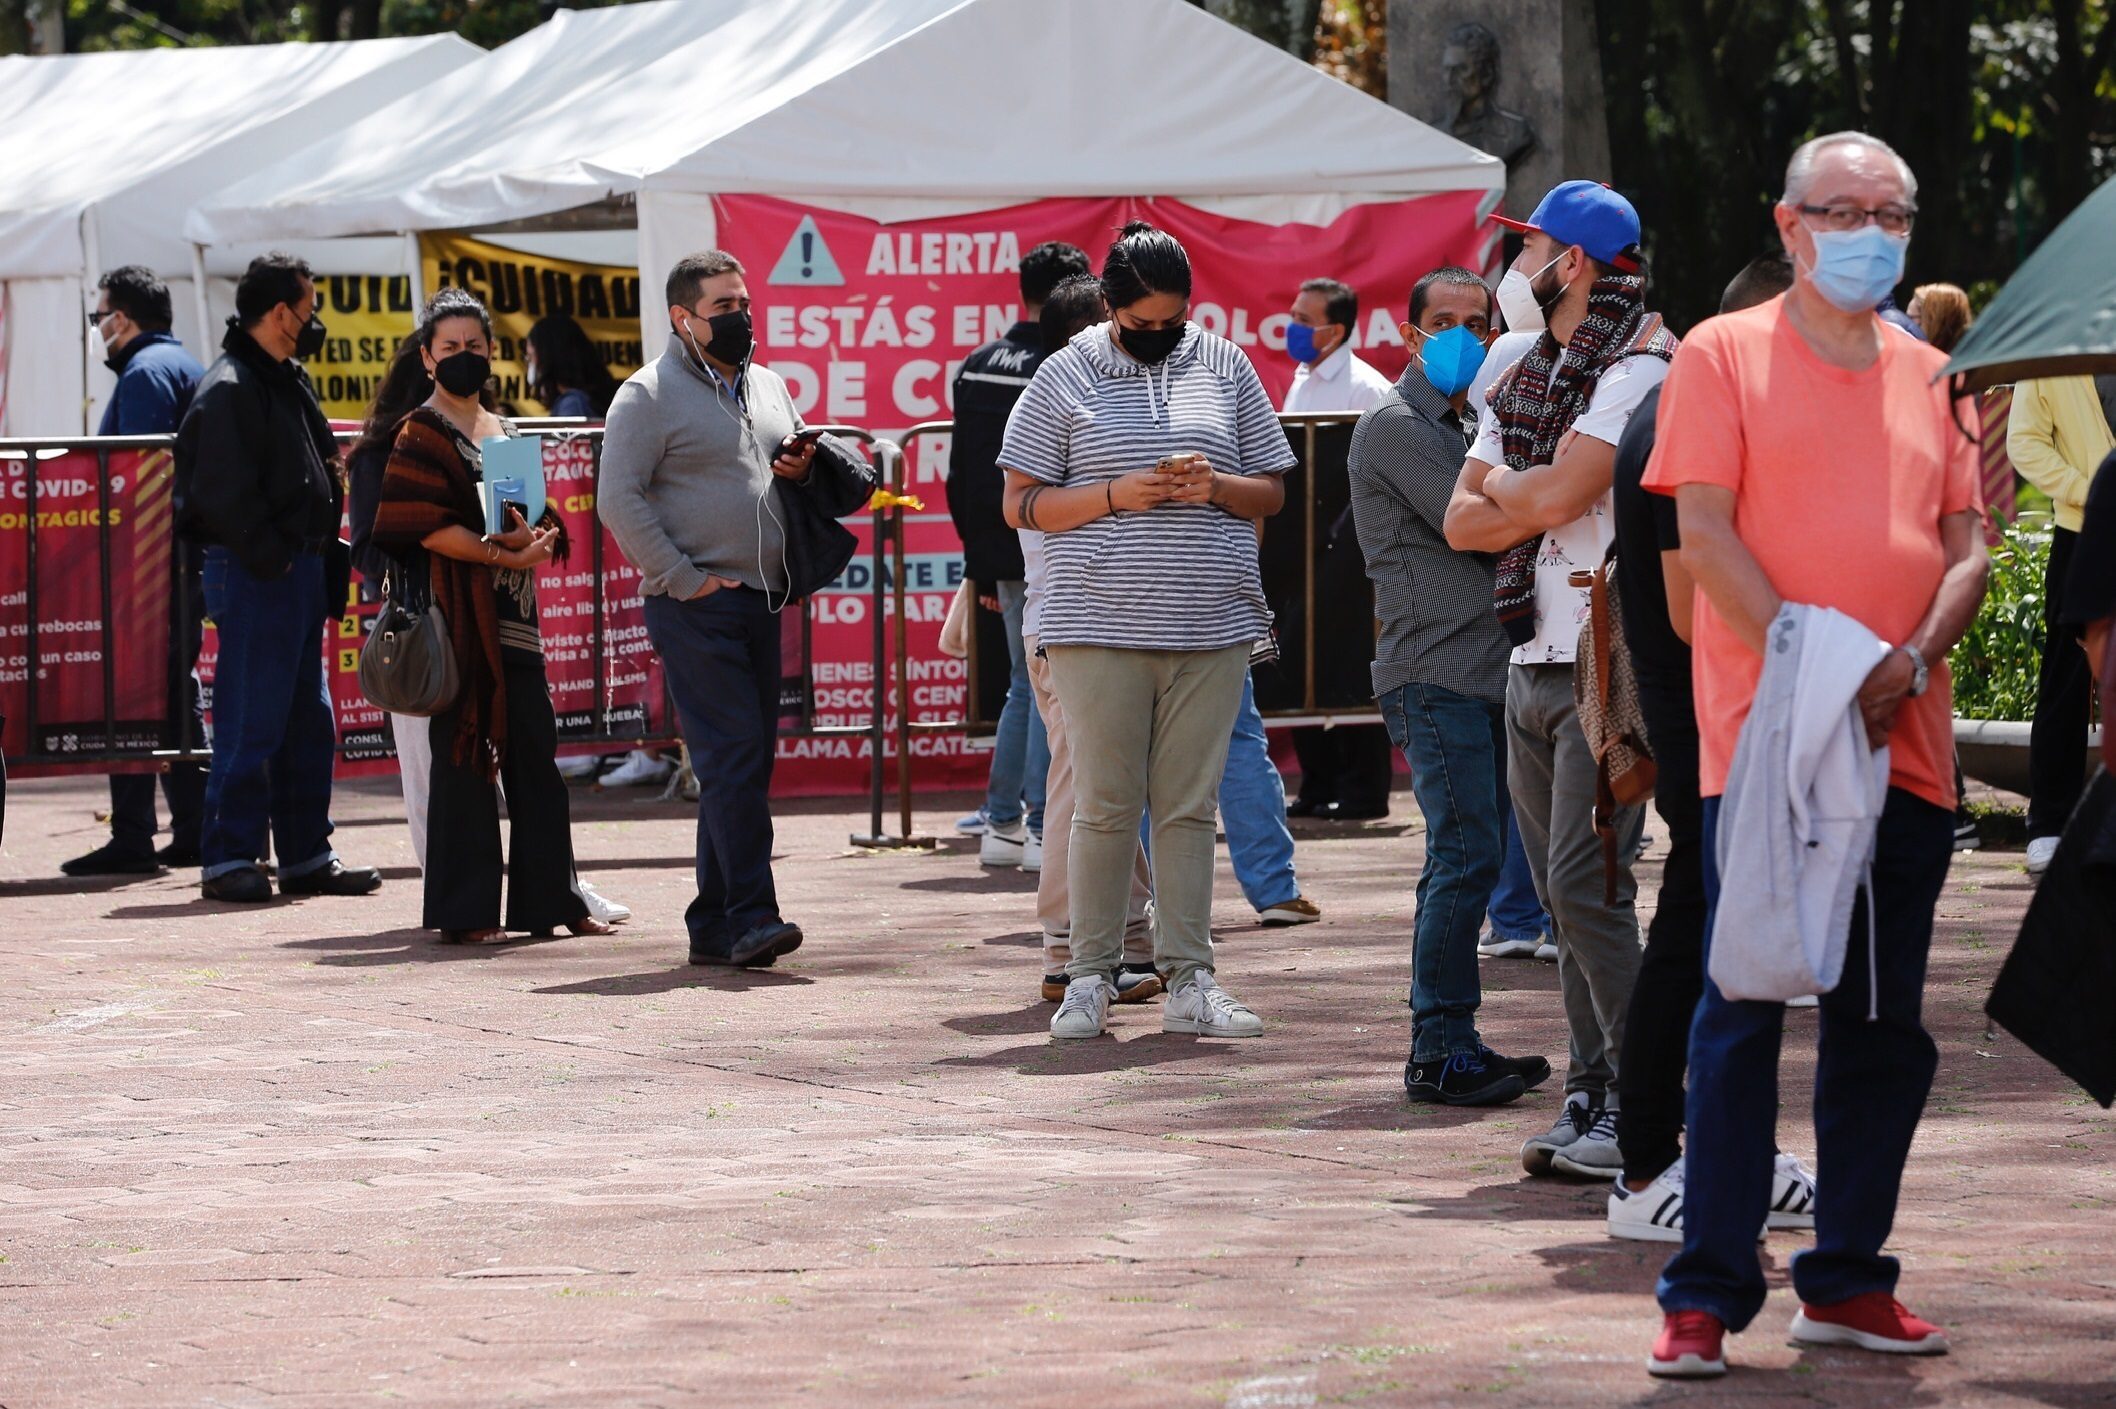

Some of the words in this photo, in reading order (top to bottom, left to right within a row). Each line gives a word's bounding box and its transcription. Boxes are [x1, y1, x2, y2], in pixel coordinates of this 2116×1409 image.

[866, 232, 1021, 275] ALERTA
[767, 295, 937, 348] ESTÁS
[953, 304, 1020, 346] EN
[767, 361, 866, 418] DE
[11, 475, 125, 499] COVID-9
[541, 576, 561, 588] no
[620, 565, 633, 579] la
[543, 604, 573, 618] aire
[10, 619, 102, 637] curebocas
[344, 618, 354, 633] 2
[41, 652, 60, 664] un
[64, 650, 102, 663] caso
[343, 653, 353, 668] 3
[580, 648, 589, 659] a
[559, 678, 594, 693] MAND
[341, 713, 357, 725] AL
[566, 715, 591, 727] UNA
[857, 738, 873, 758] A
